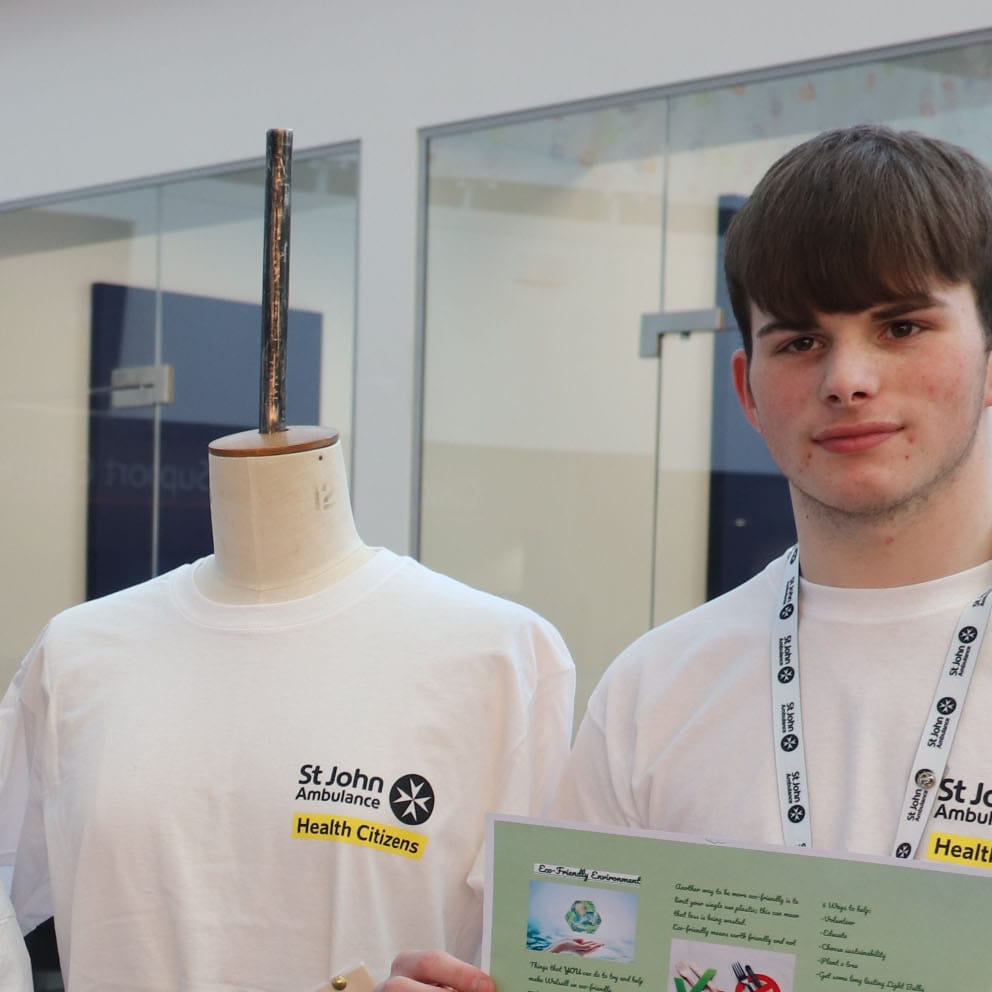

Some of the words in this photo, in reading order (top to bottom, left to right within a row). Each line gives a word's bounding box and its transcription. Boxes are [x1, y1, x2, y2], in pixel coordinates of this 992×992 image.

[784, 645, 792, 665] John
[952, 645, 965, 666] John
[787, 712, 795, 732] John
[930, 716, 944, 737] John
[927, 739, 938, 748] St
[298, 764, 323, 786] St
[325, 766, 384, 793] John
[295, 787, 381, 809] Ambulance
[792, 782, 801, 803] John
[910, 789, 922, 809] John
[937, 778, 967, 803] St
[907, 812, 916, 821] St
[297, 817, 352, 837] Health
[356, 824, 419, 854] Citizens
[538, 864, 589, 881] Eco-Friendly
[591, 871, 641, 885] Environment
[564, 966, 581, 975] YOU
